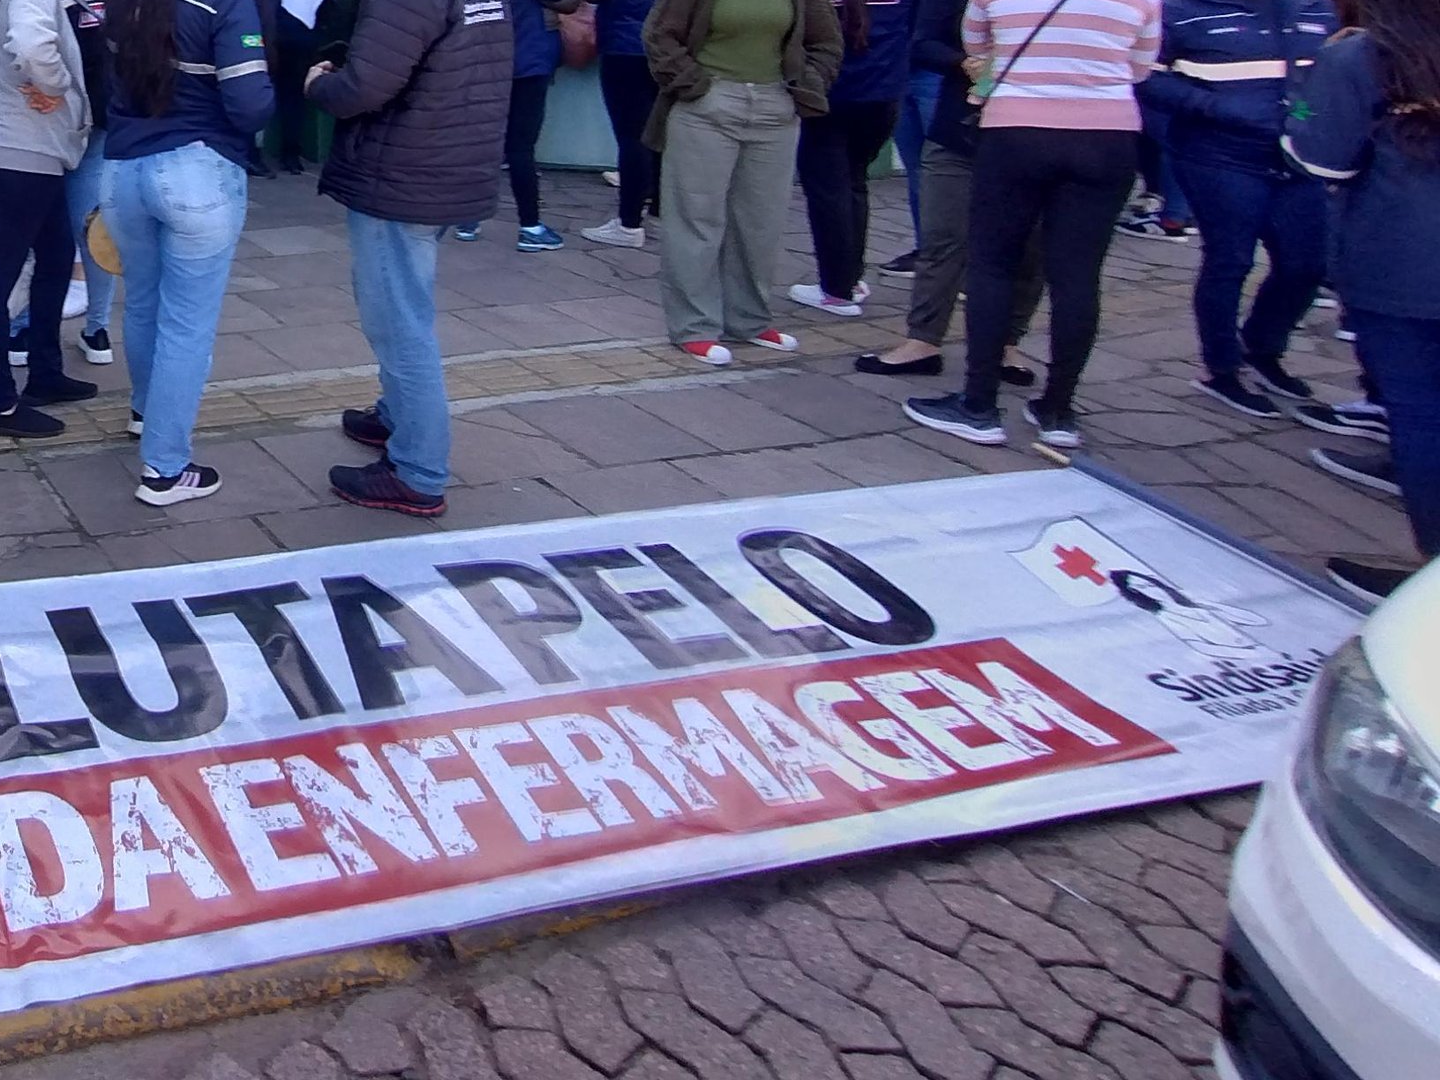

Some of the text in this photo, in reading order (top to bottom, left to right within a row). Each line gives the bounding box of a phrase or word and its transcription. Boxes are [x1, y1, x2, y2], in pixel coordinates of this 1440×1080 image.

[434, 528, 937, 687] PELO
[198, 660, 1124, 894] ENFERMAGEM
[1195, 696, 1287, 720] Filiado
